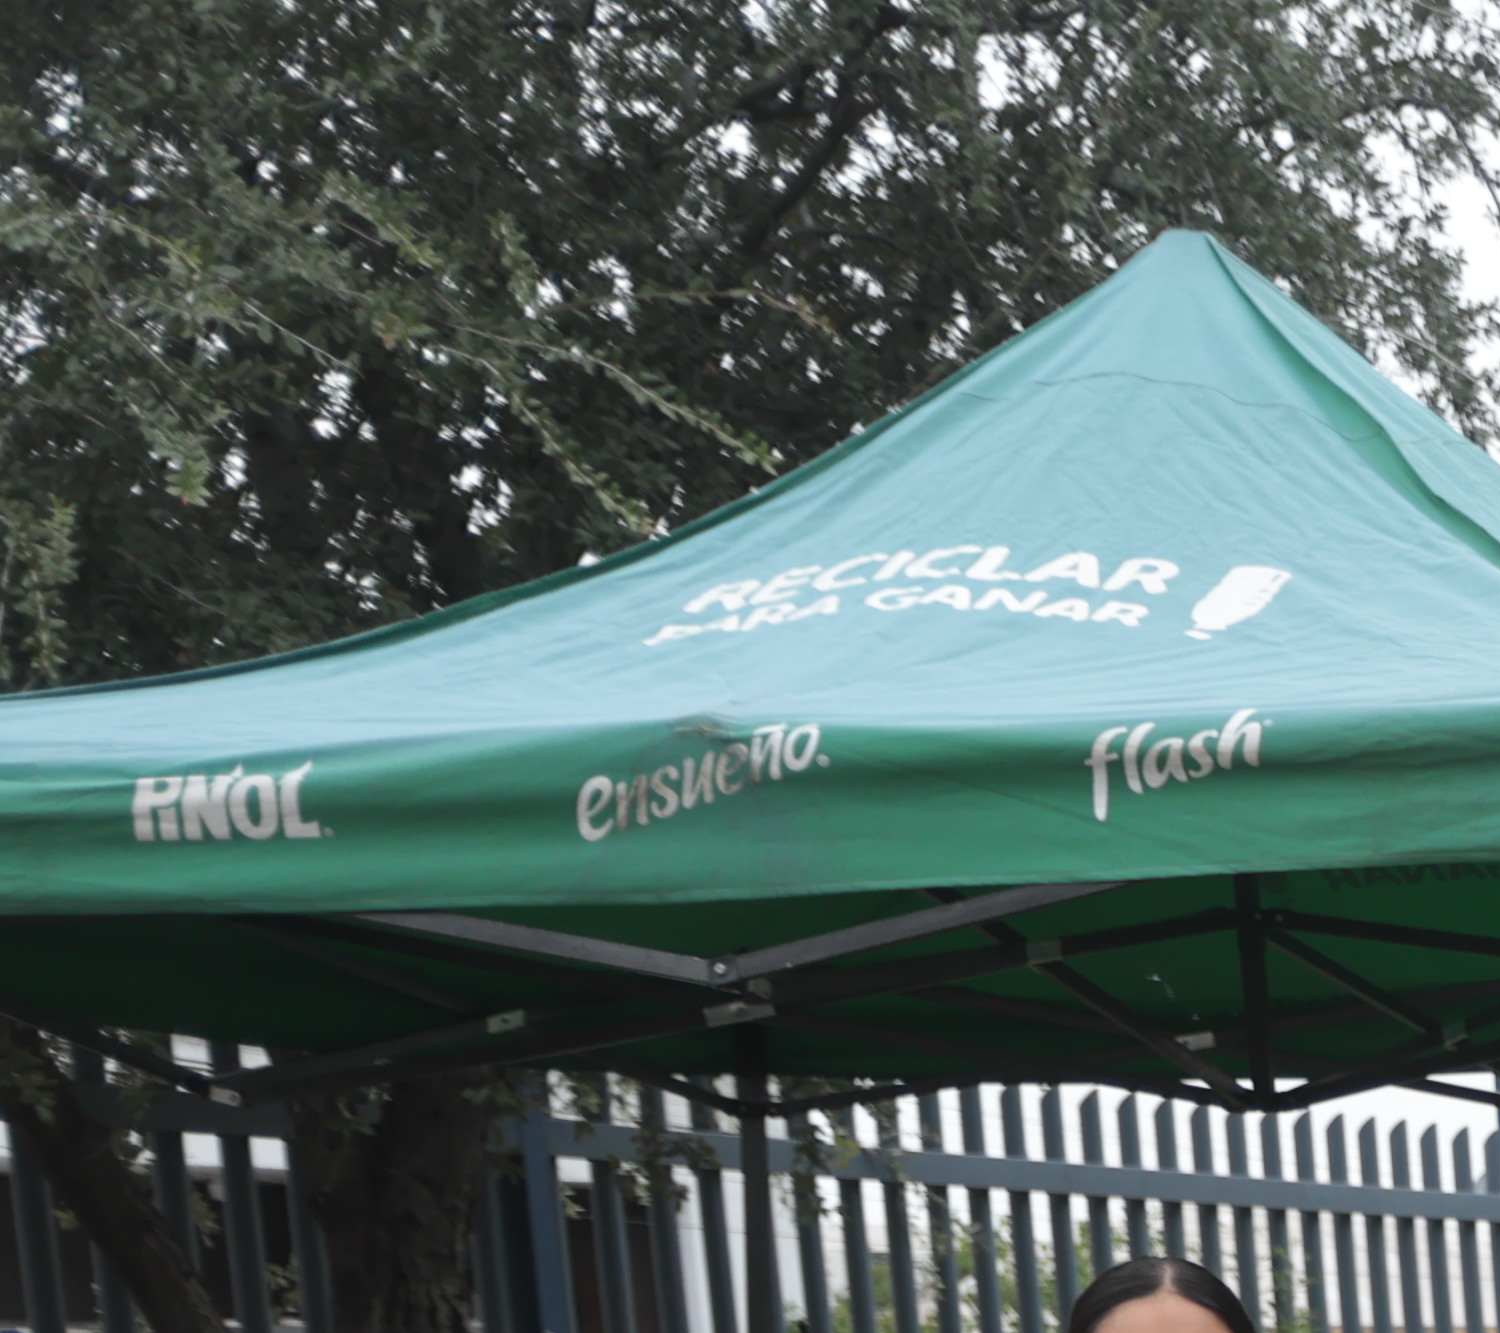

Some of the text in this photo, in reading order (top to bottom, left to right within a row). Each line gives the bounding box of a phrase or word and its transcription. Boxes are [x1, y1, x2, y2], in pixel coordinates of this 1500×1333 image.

[642, 585, 1149, 647] PARA GANAR
[683, 544, 1180, 614] RECICLAR
[576, 721, 821, 842] ensueño
[1084, 707, 1263, 823] flash
